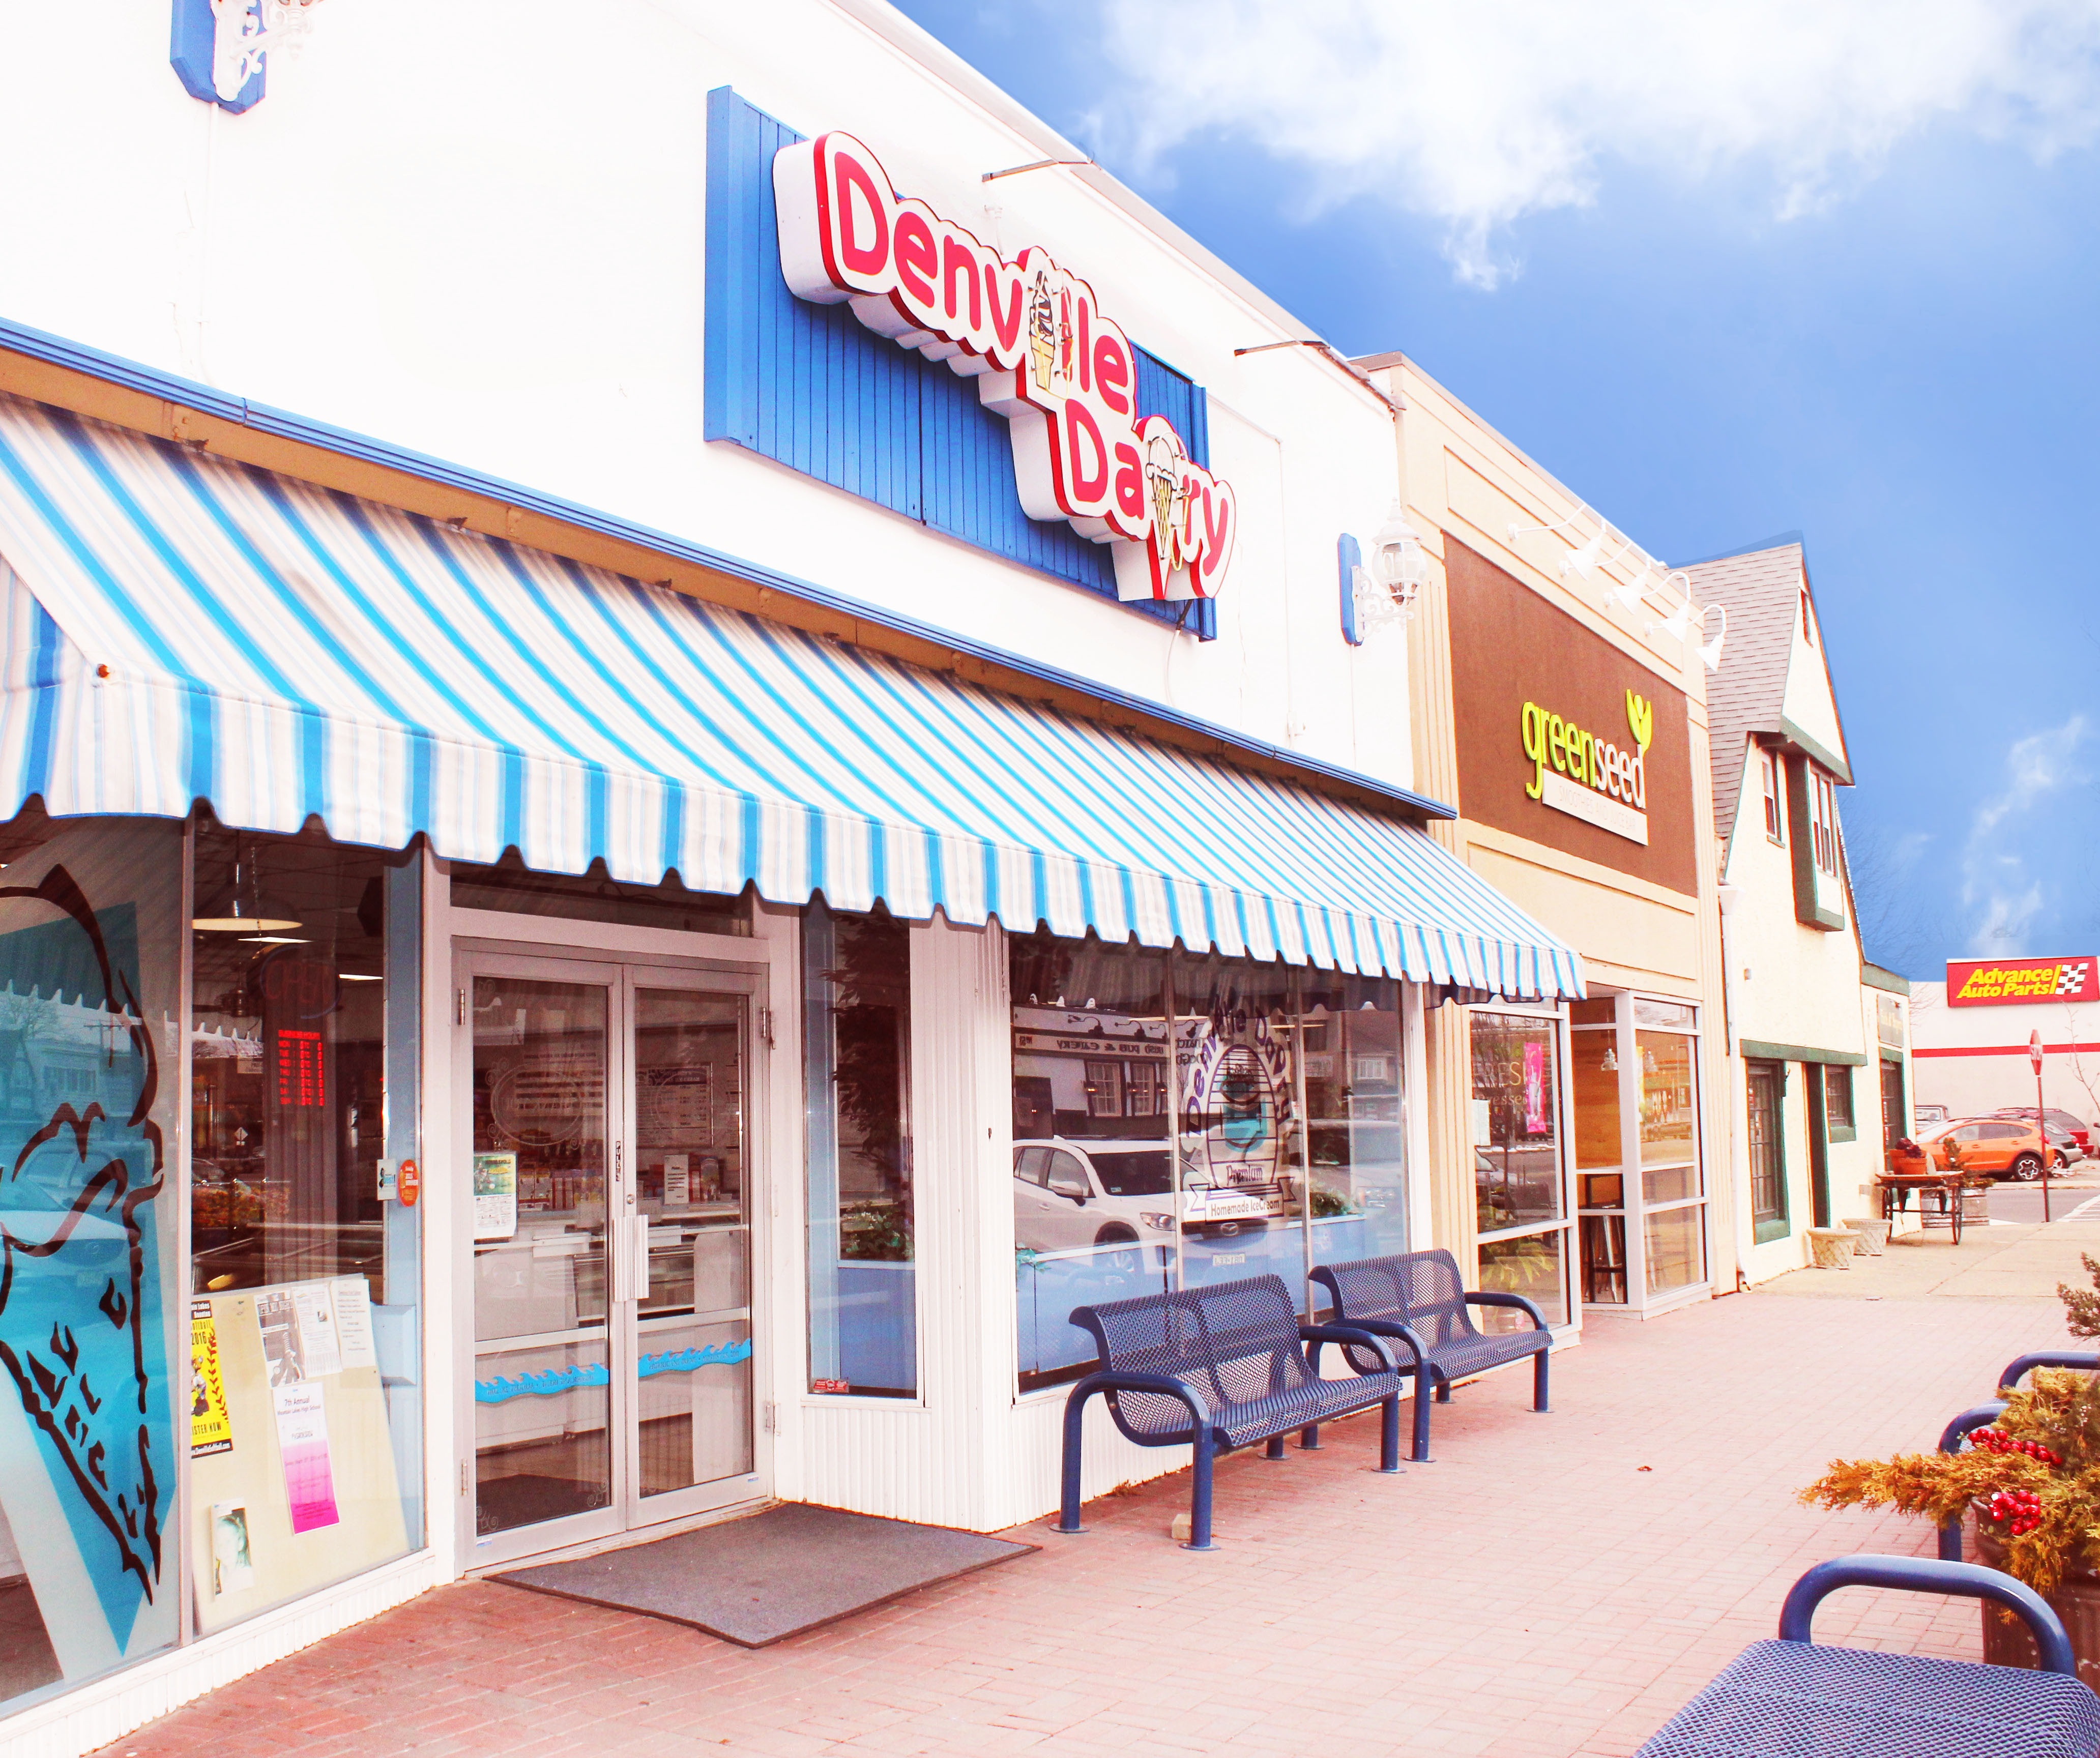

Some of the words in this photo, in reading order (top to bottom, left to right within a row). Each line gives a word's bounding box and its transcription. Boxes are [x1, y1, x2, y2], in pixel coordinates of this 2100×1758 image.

[833, 151, 1130, 415] Denville
[1064, 398, 1229, 578] Dairy
[1522, 701, 1646, 809] greenseed
[1966, 967, 2053, 985] Advance
[1957, 984, 2001, 998] Auto
[2002, 982, 2050, 997] Parts
[1226, 1164, 1263, 1187] Premium
[1211, 1200, 1249, 1217] Homemade
[192, 1320, 211, 1330] oftball
